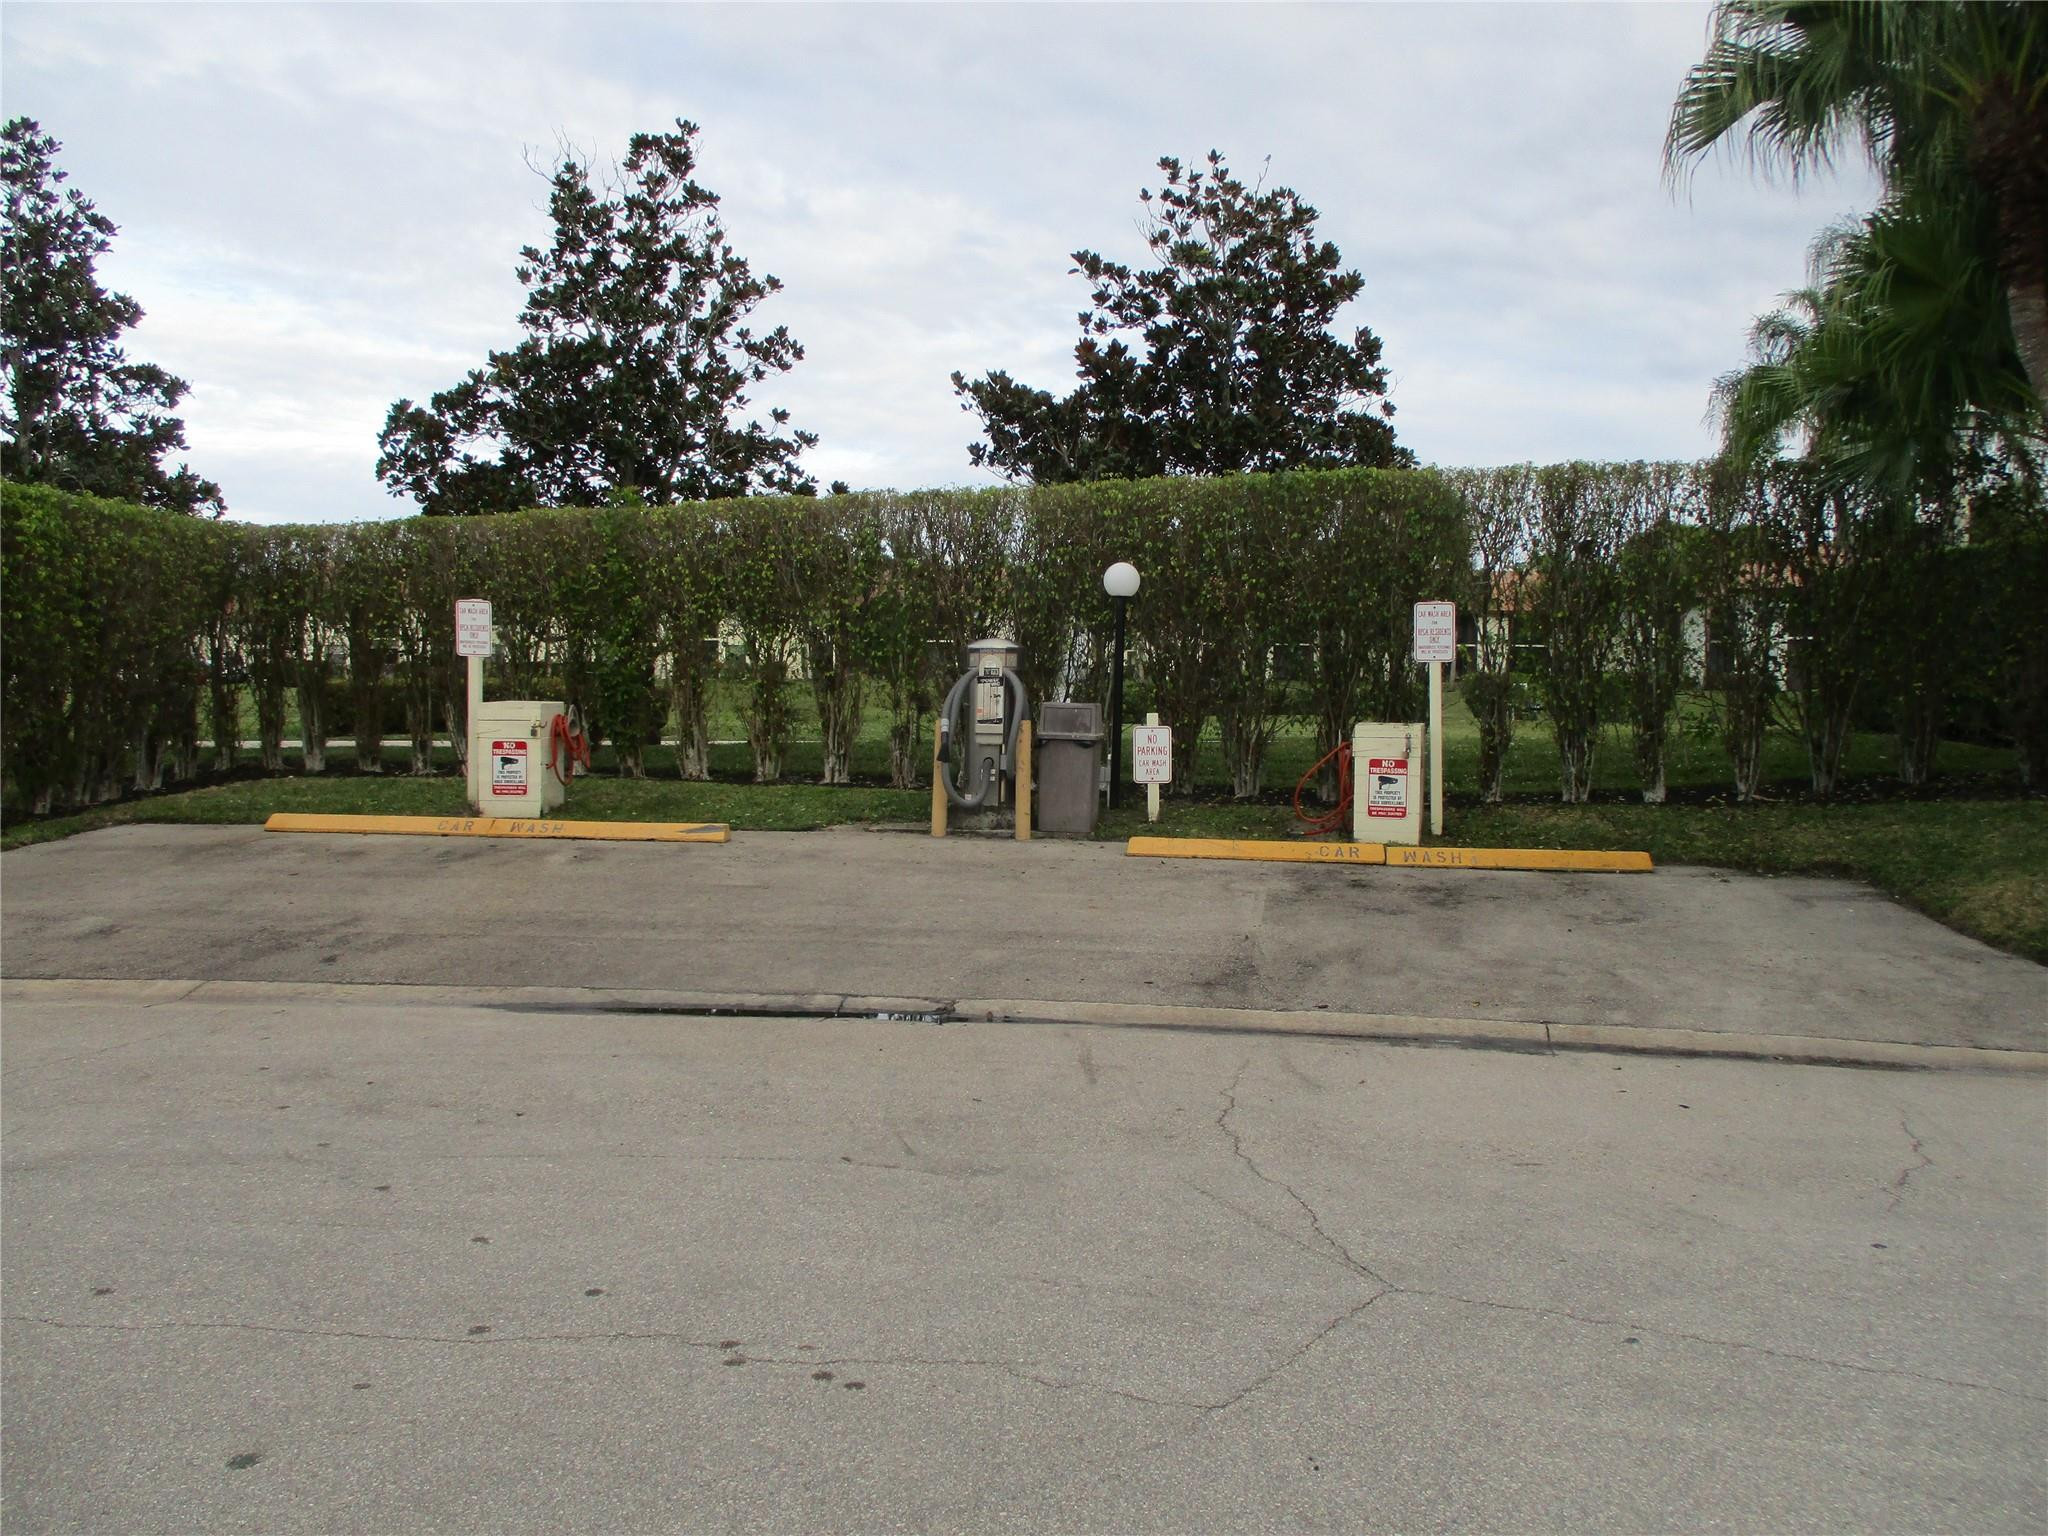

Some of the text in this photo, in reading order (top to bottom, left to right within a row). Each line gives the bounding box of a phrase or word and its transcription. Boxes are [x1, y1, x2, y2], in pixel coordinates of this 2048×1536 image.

[1147, 734, 1158, 744] NO
[1137, 746, 1168, 756] PARKING
[1382, 760, 1395, 768] NO
[1370, 767, 1407, 775] TRESPASSING
[437, 820, 564, 833] CAR WASH
[1319, 845, 1462, 864] CAR WASH
